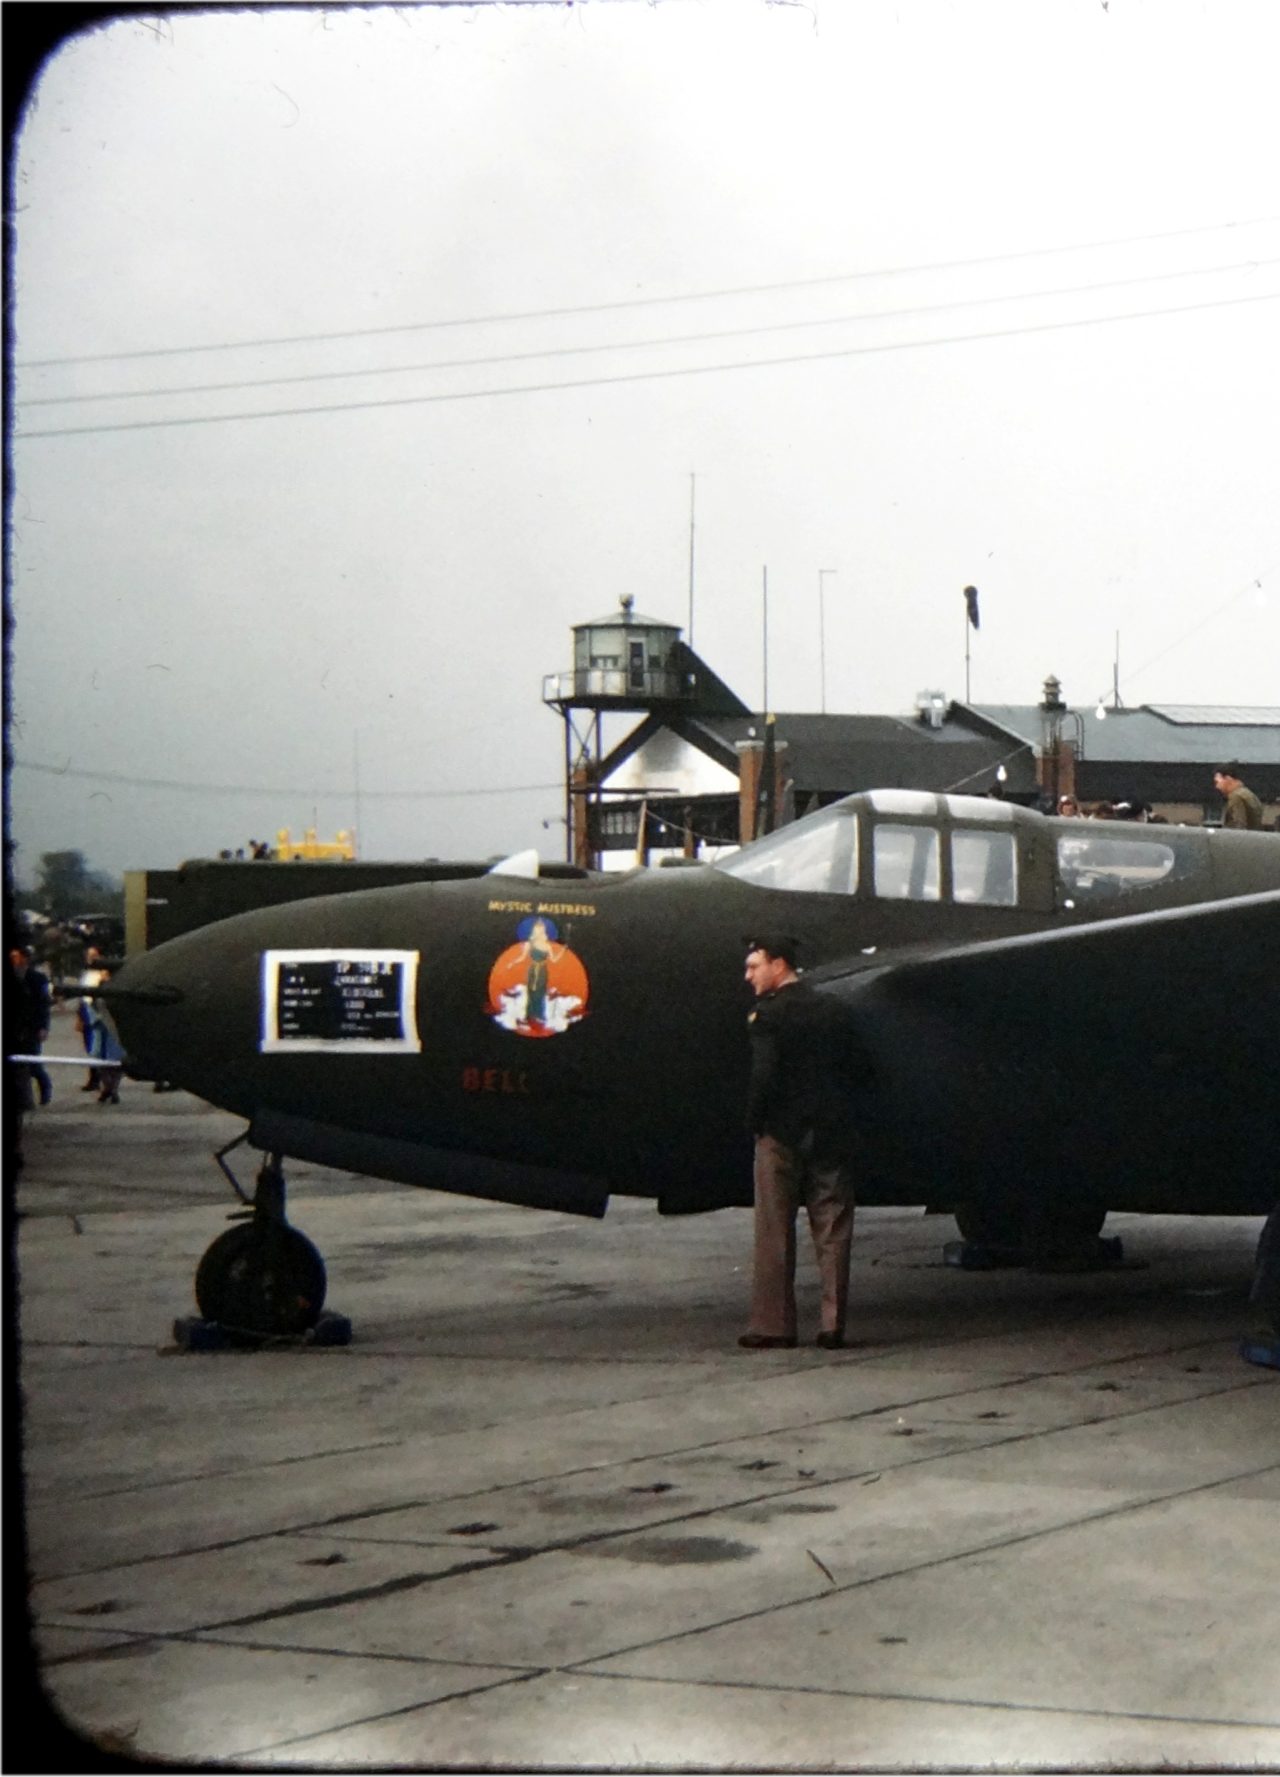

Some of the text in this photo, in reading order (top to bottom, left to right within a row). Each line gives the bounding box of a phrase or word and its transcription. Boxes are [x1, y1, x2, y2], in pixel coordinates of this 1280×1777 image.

[487, 900, 596, 916] MYSTIC MISTRESS
[462, 1064, 529, 1094] BELL
